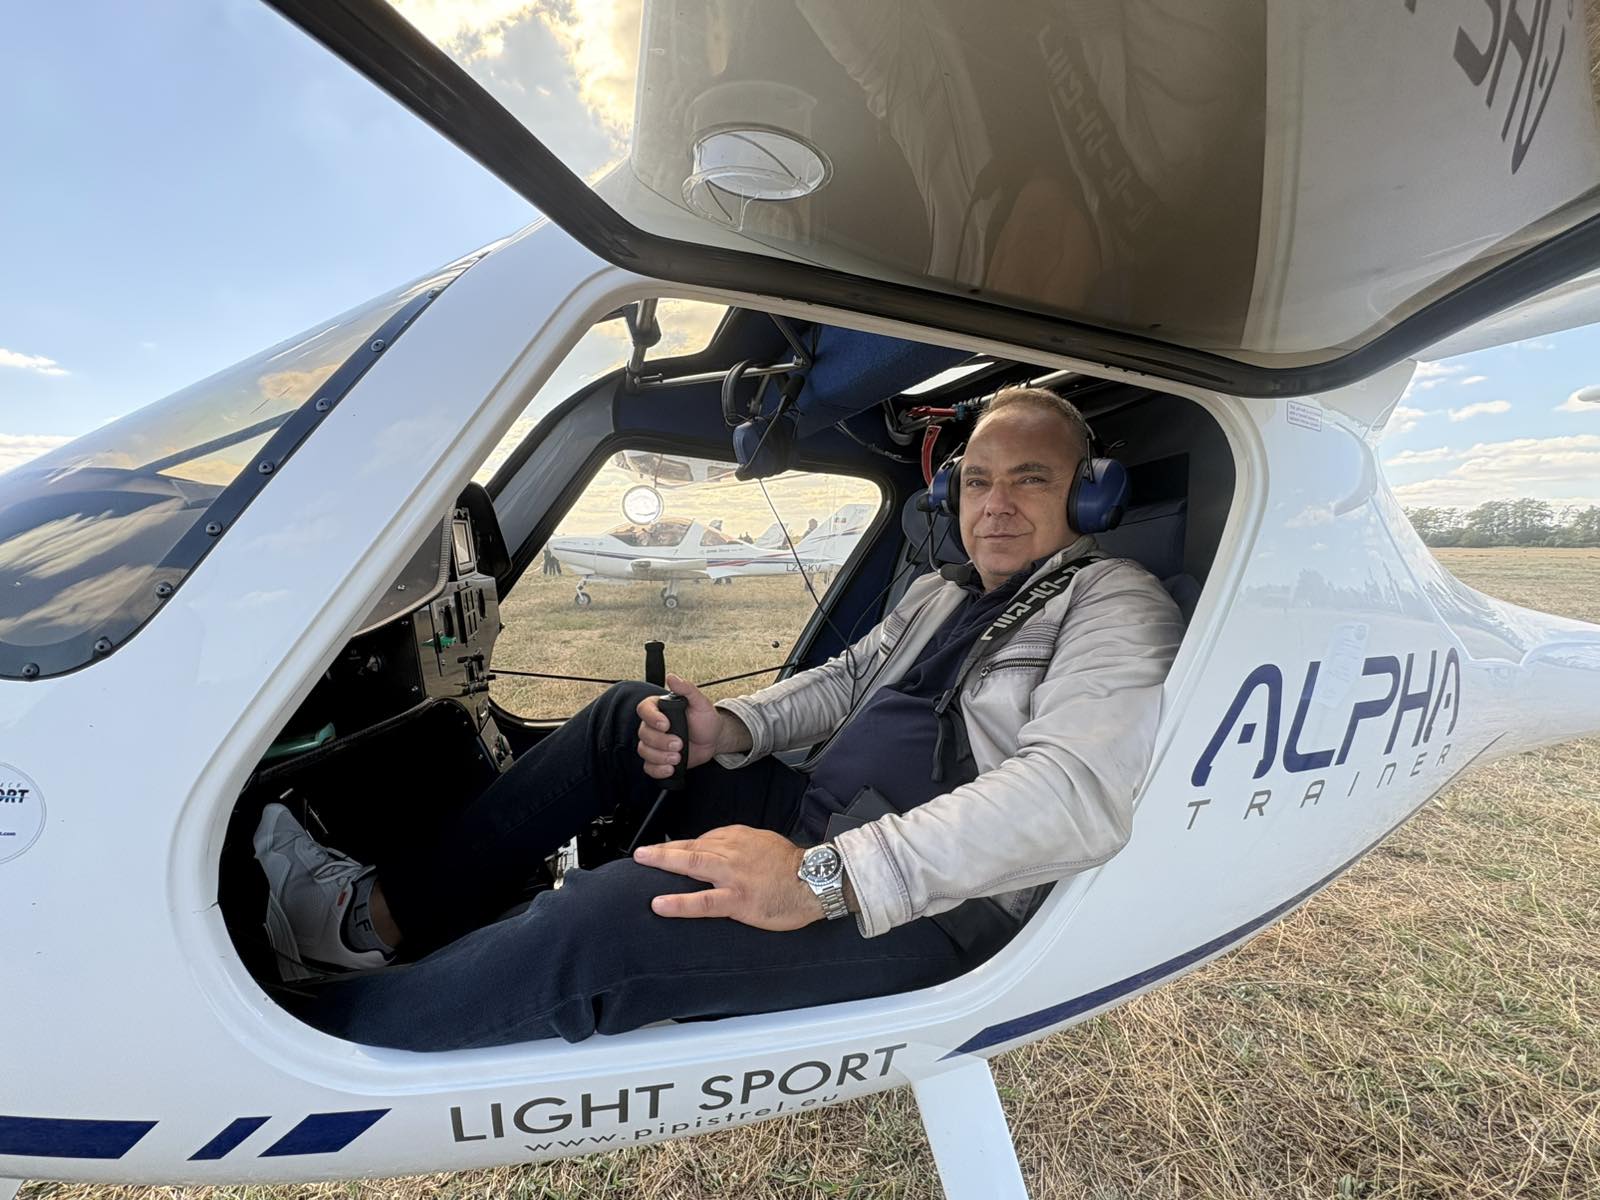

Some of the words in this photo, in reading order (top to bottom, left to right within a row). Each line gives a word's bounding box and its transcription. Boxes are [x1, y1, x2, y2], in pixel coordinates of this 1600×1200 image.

[1190, 647, 1461, 787] ALPHA
[1186, 743, 1452, 830] TRAINER
[449, 1082, 675, 1143] LIGHT
[698, 1042, 908, 1111] SPORT
[524, 1092, 840, 1152] www.pipistrel.eu
